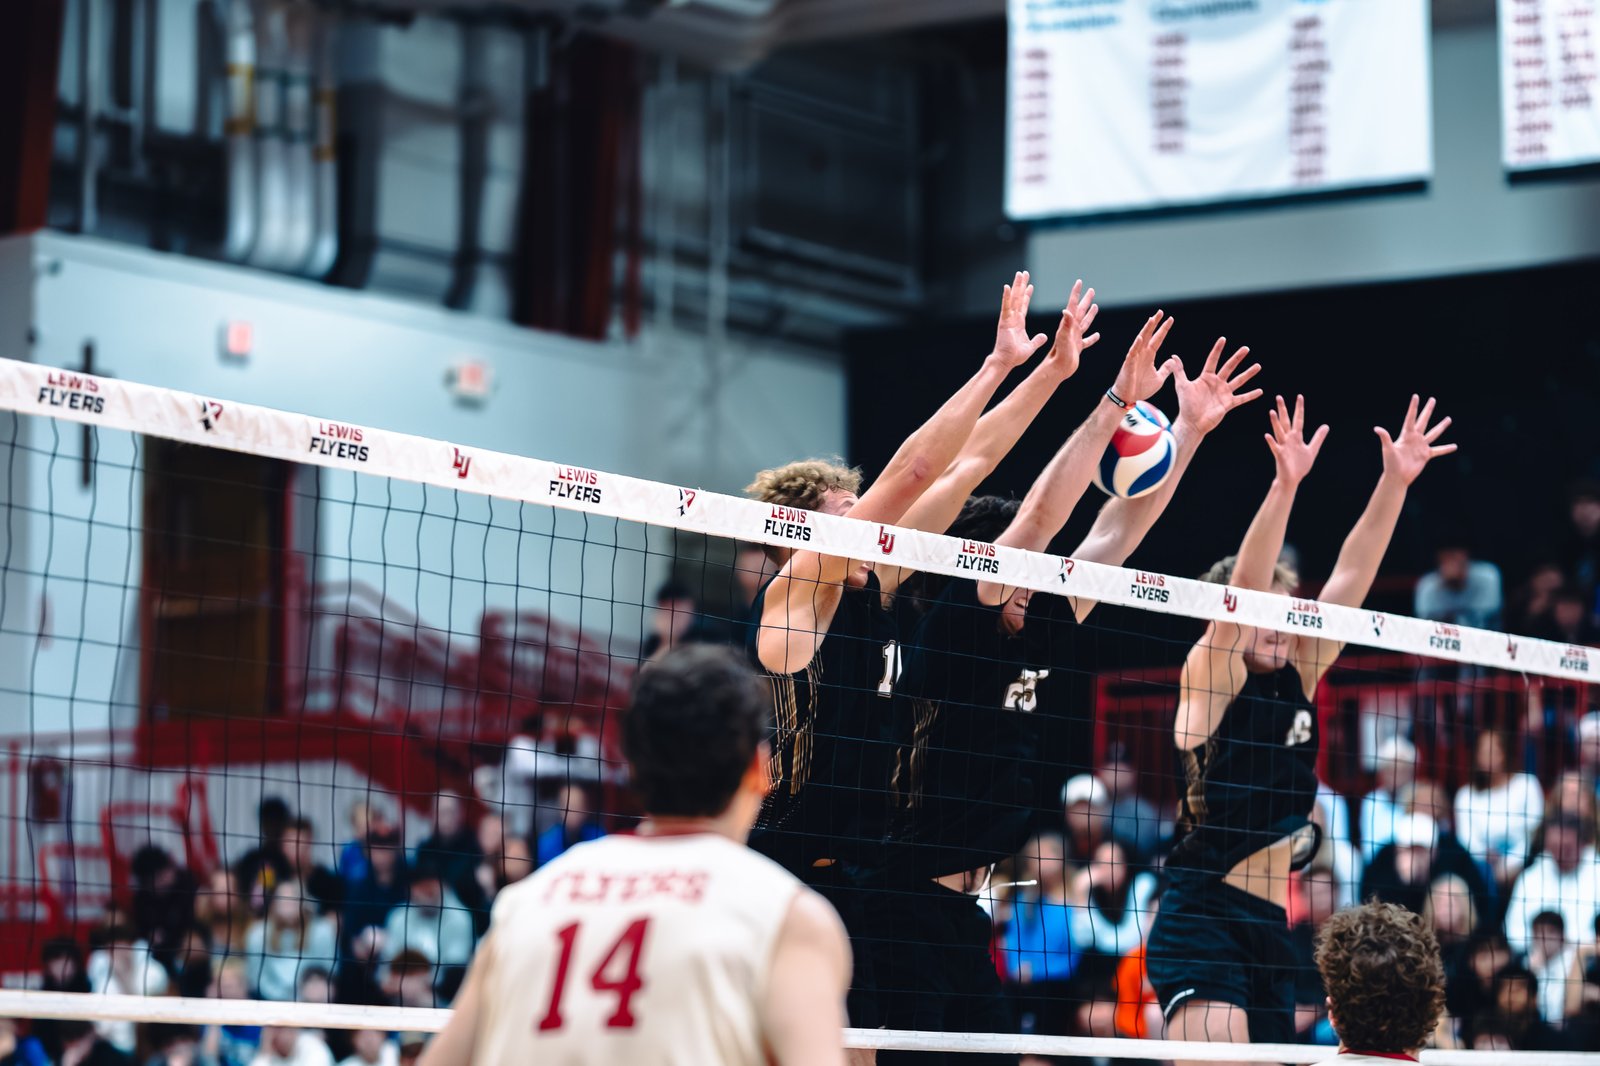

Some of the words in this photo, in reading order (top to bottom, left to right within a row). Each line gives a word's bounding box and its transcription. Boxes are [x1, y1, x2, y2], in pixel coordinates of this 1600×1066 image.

[47, 371, 99, 392] LEWIS
[37, 387, 104, 414] FLYERS
[319, 422, 363, 442] LEWIS
[309, 437, 369, 462] FLYERS
[558, 466, 598, 485] LEWIS
[549, 480, 601, 504] FLYERS
[771, 505, 807, 523] LEWIS
[764, 519, 811, 541] FLYERS
[878, 526, 896, 555] LU
[962, 540, 996, 557] LEWIS
[956, 554, 1000, 574] FLYERS
[1135, 571, 1165, 587] LEWIS
[1130, 584, 1170, 603] FLYERS
[1292, 600, 1320, 614] LEWIS
[1286, 611, 1322, 629] FLYERS
[538, 916, 653, 1033] 14
